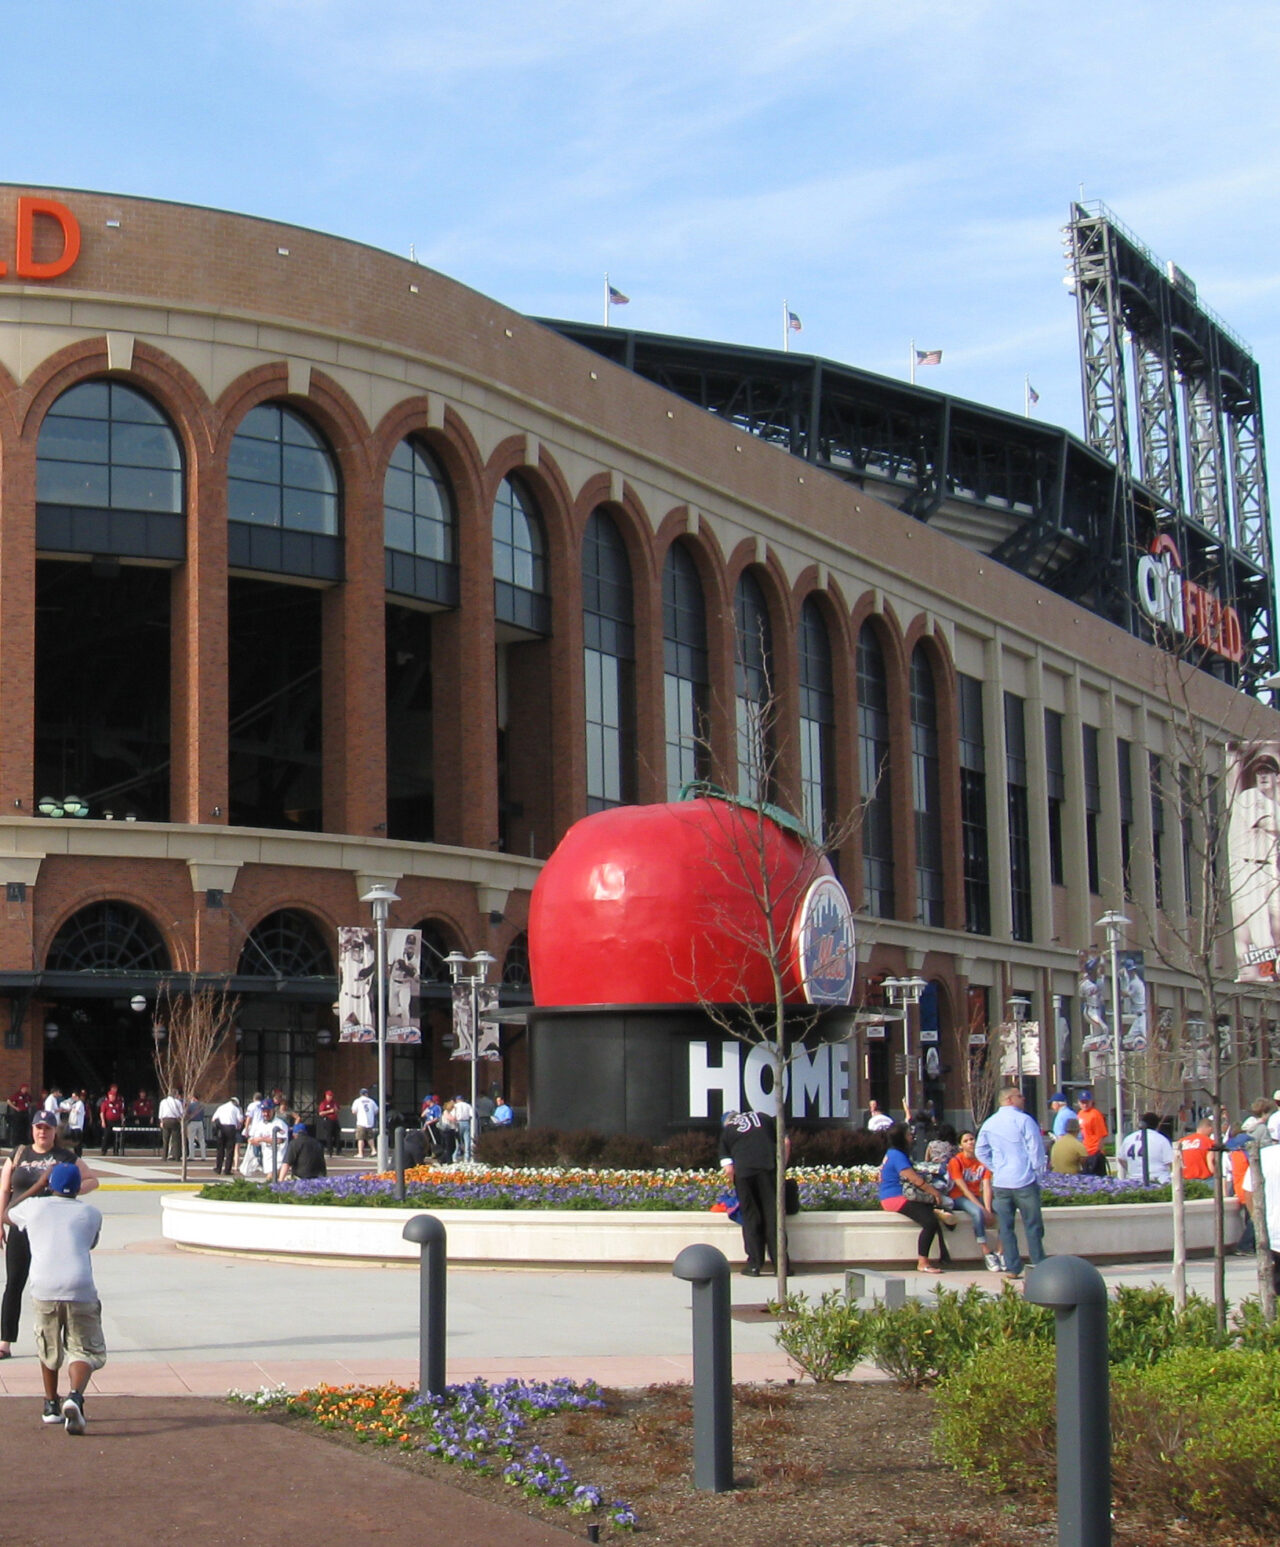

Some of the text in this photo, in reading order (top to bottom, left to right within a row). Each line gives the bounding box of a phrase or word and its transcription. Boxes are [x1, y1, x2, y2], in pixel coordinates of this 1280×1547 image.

[1183, 580, 1242, 663] FIELD
[813, 934, 847, 980] Mets
[689, 1041, 850, 1118] HOME
[737, 1111, 761, 1132] 31
